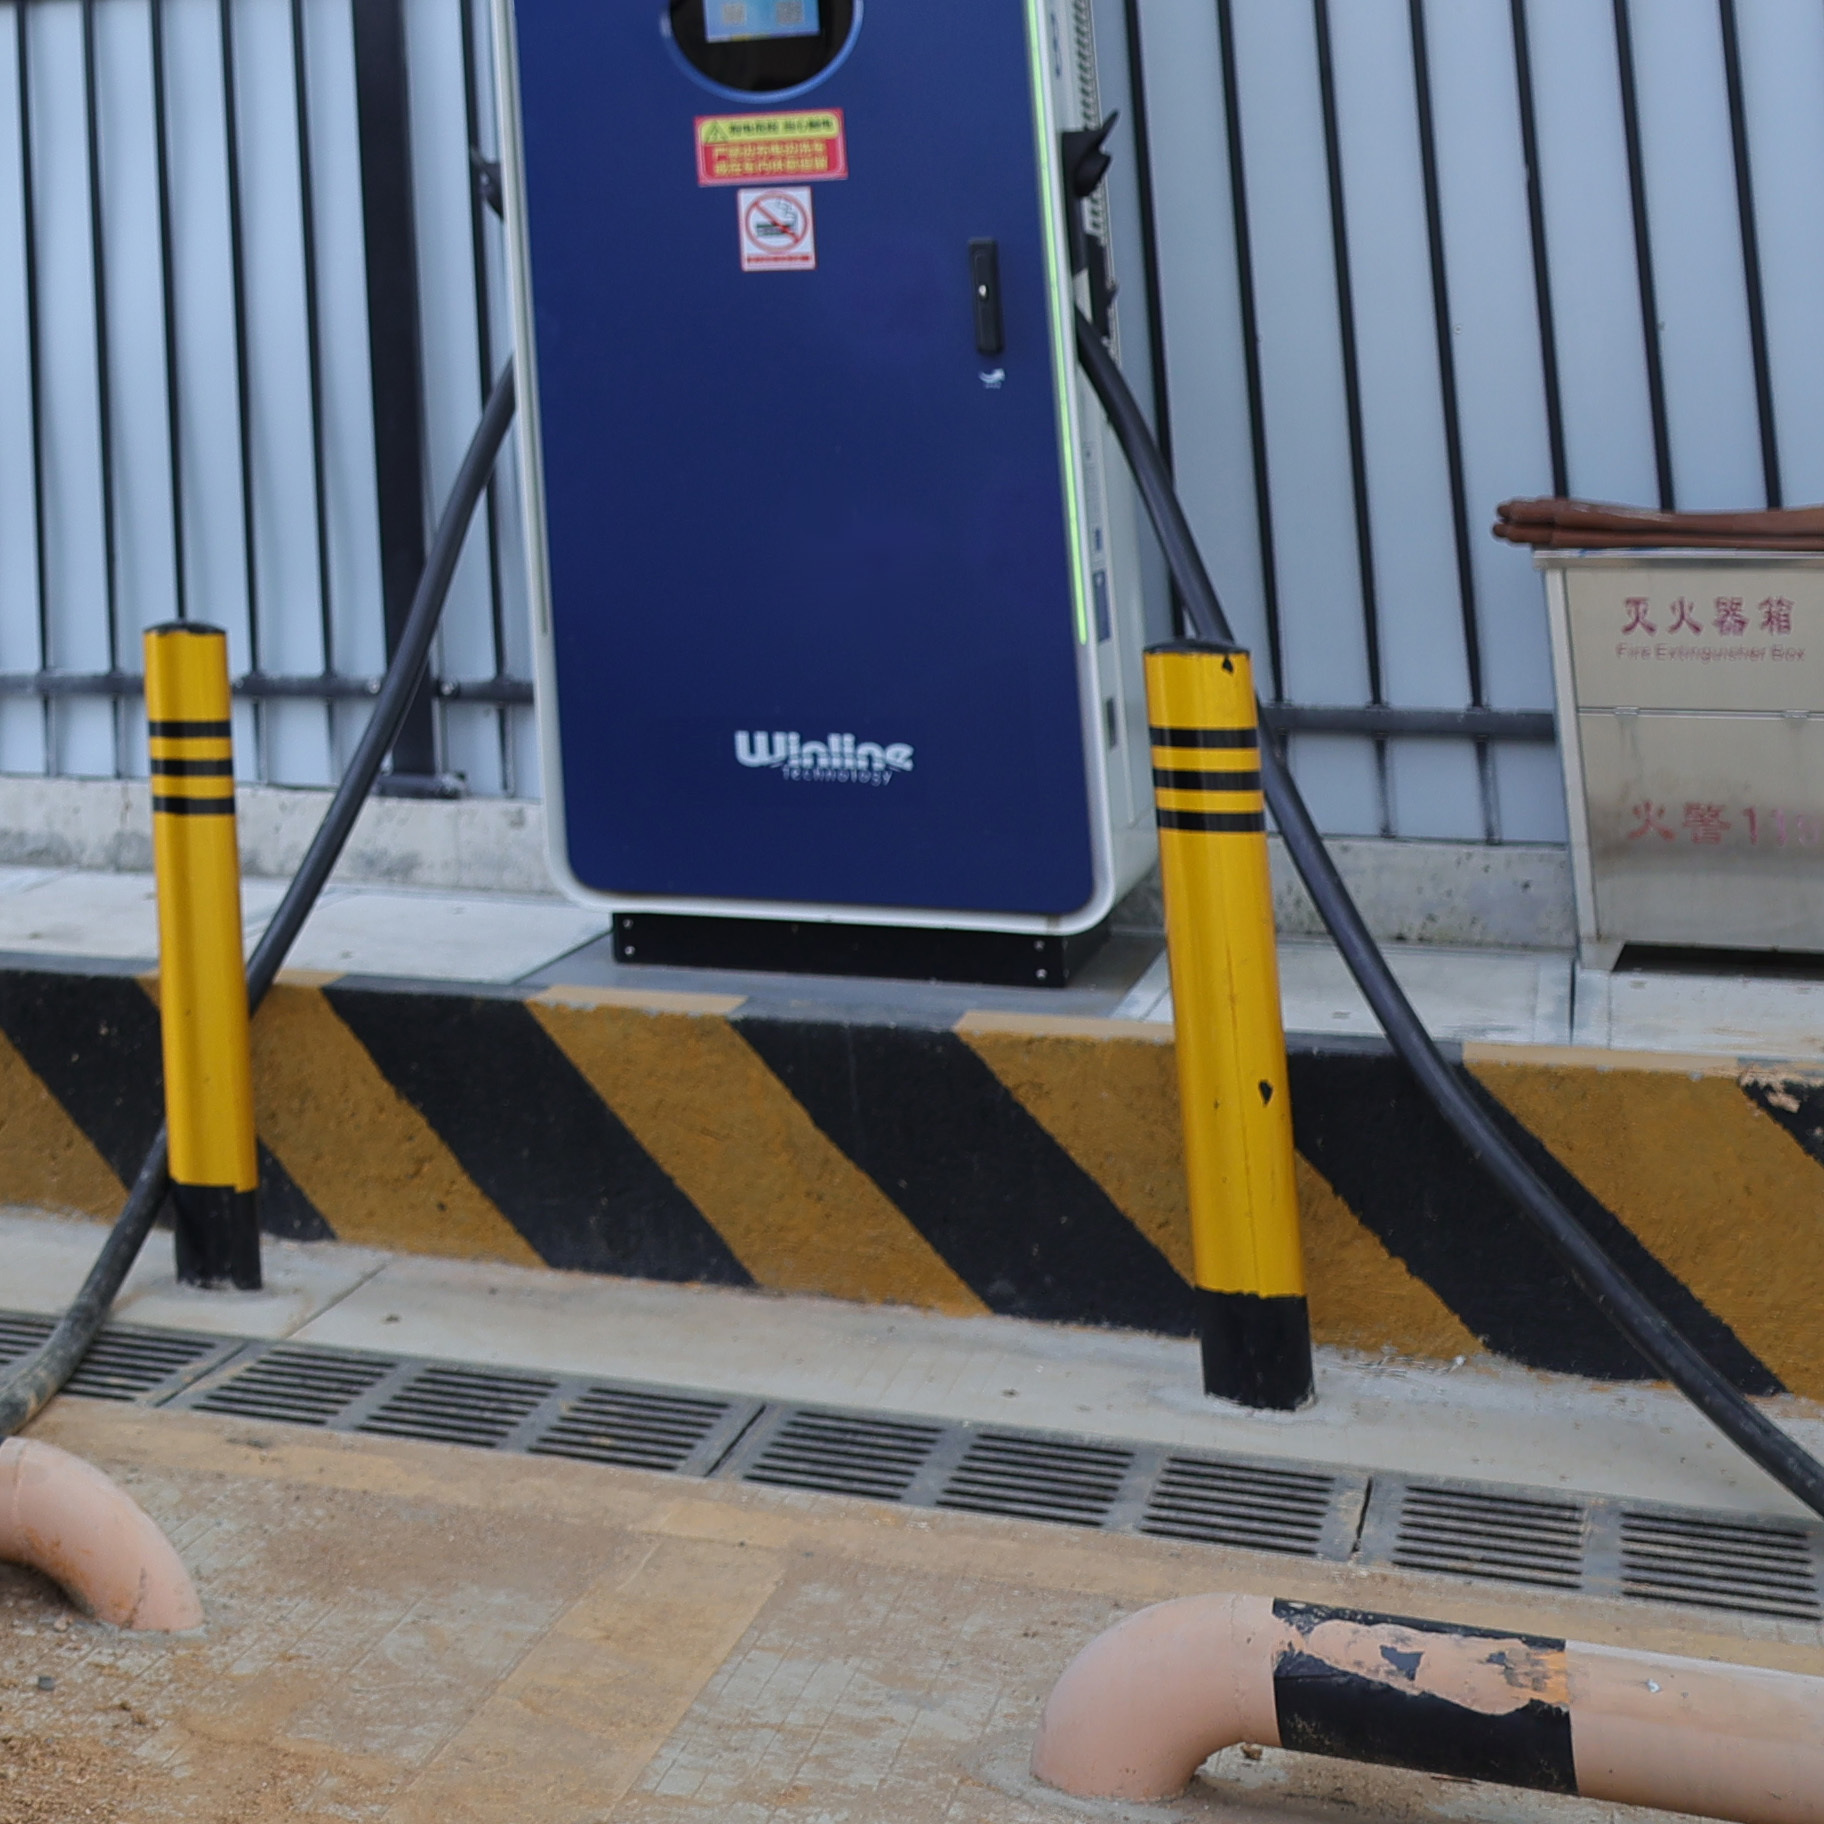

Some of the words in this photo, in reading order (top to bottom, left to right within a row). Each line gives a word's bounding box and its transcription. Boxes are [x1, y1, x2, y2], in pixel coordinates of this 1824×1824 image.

[1622, 596, 1795, 636] 灭火器箱
[1615, 642, 1651, 659] Fire
[1656, 643, 1766, 664] Extinguisher
[1772, 644, 1805, 661] Box
[734, 730, 914, 771] Winline
